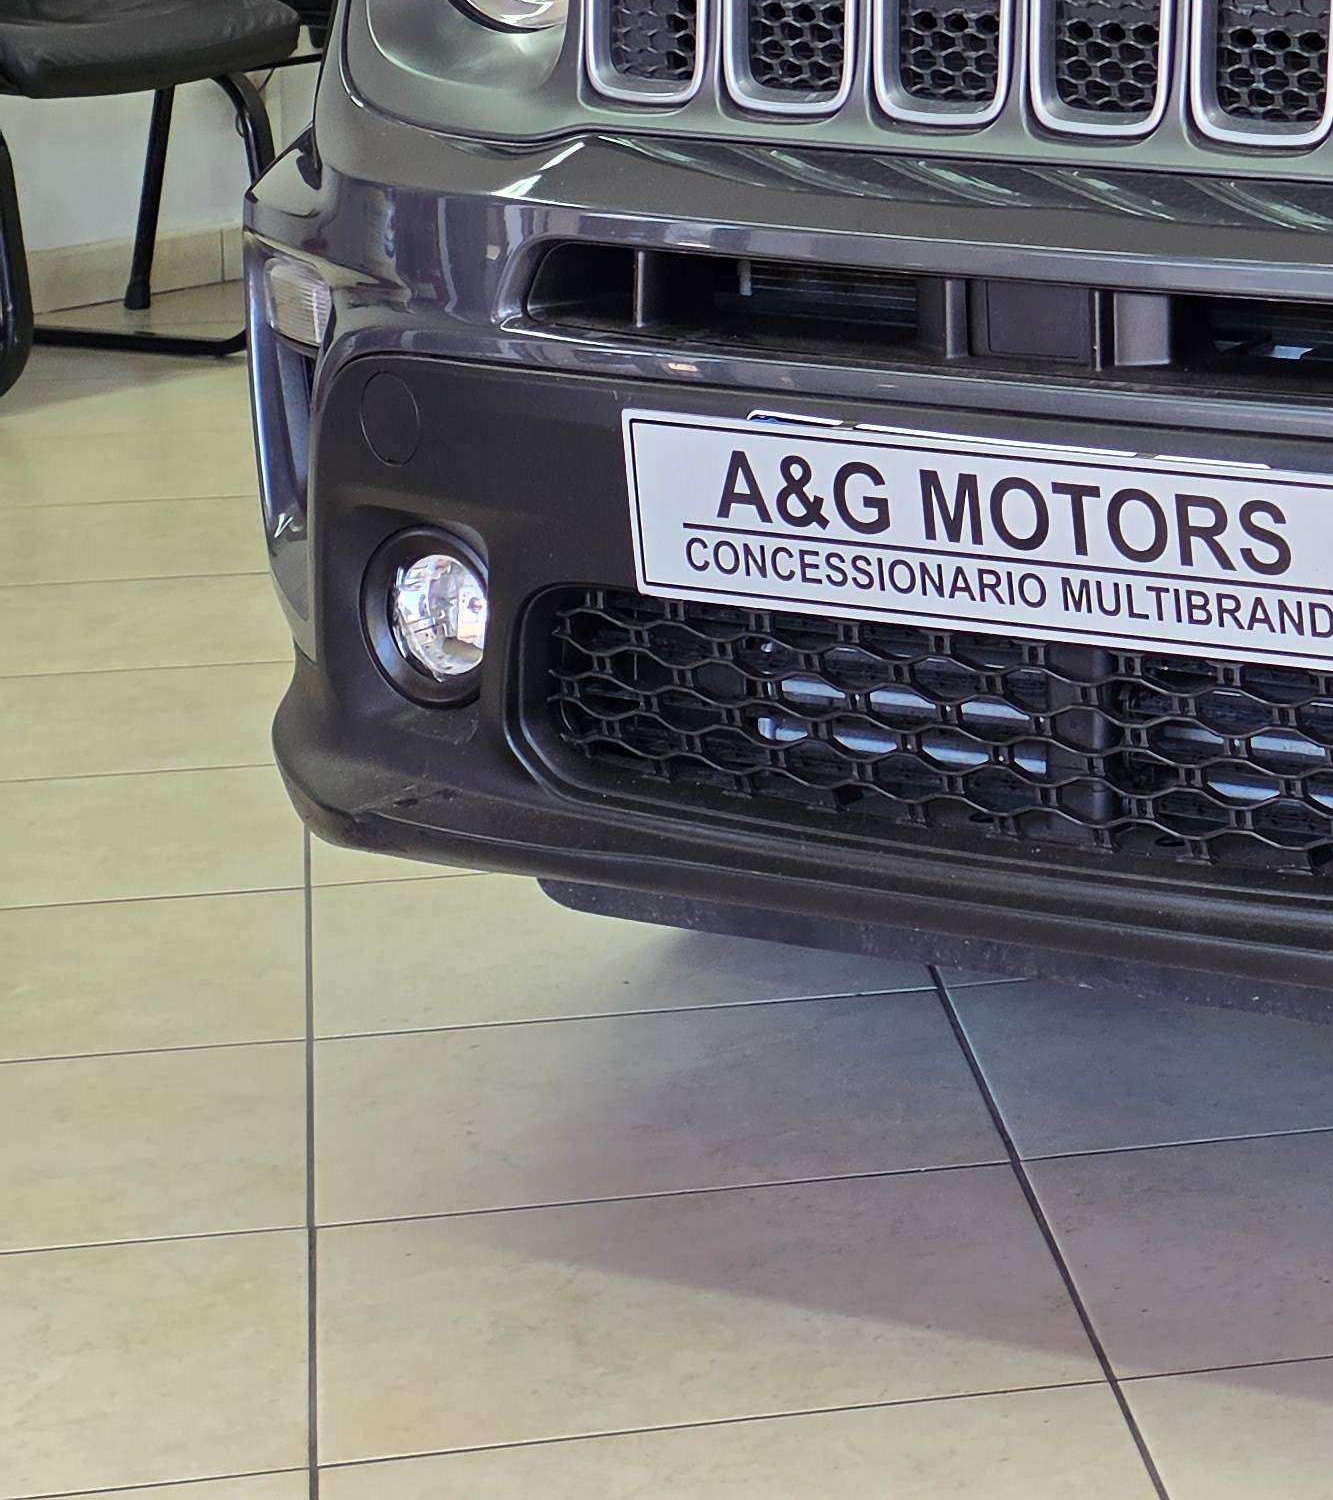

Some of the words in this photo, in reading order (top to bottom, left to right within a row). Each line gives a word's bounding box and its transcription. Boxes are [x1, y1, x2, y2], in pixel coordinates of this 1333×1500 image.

[716, 450, 891, 534] A&G
[920, 470, 1292, 575] MOTORS
[686, 537, 1046, 609] CONCESSIONARIO
